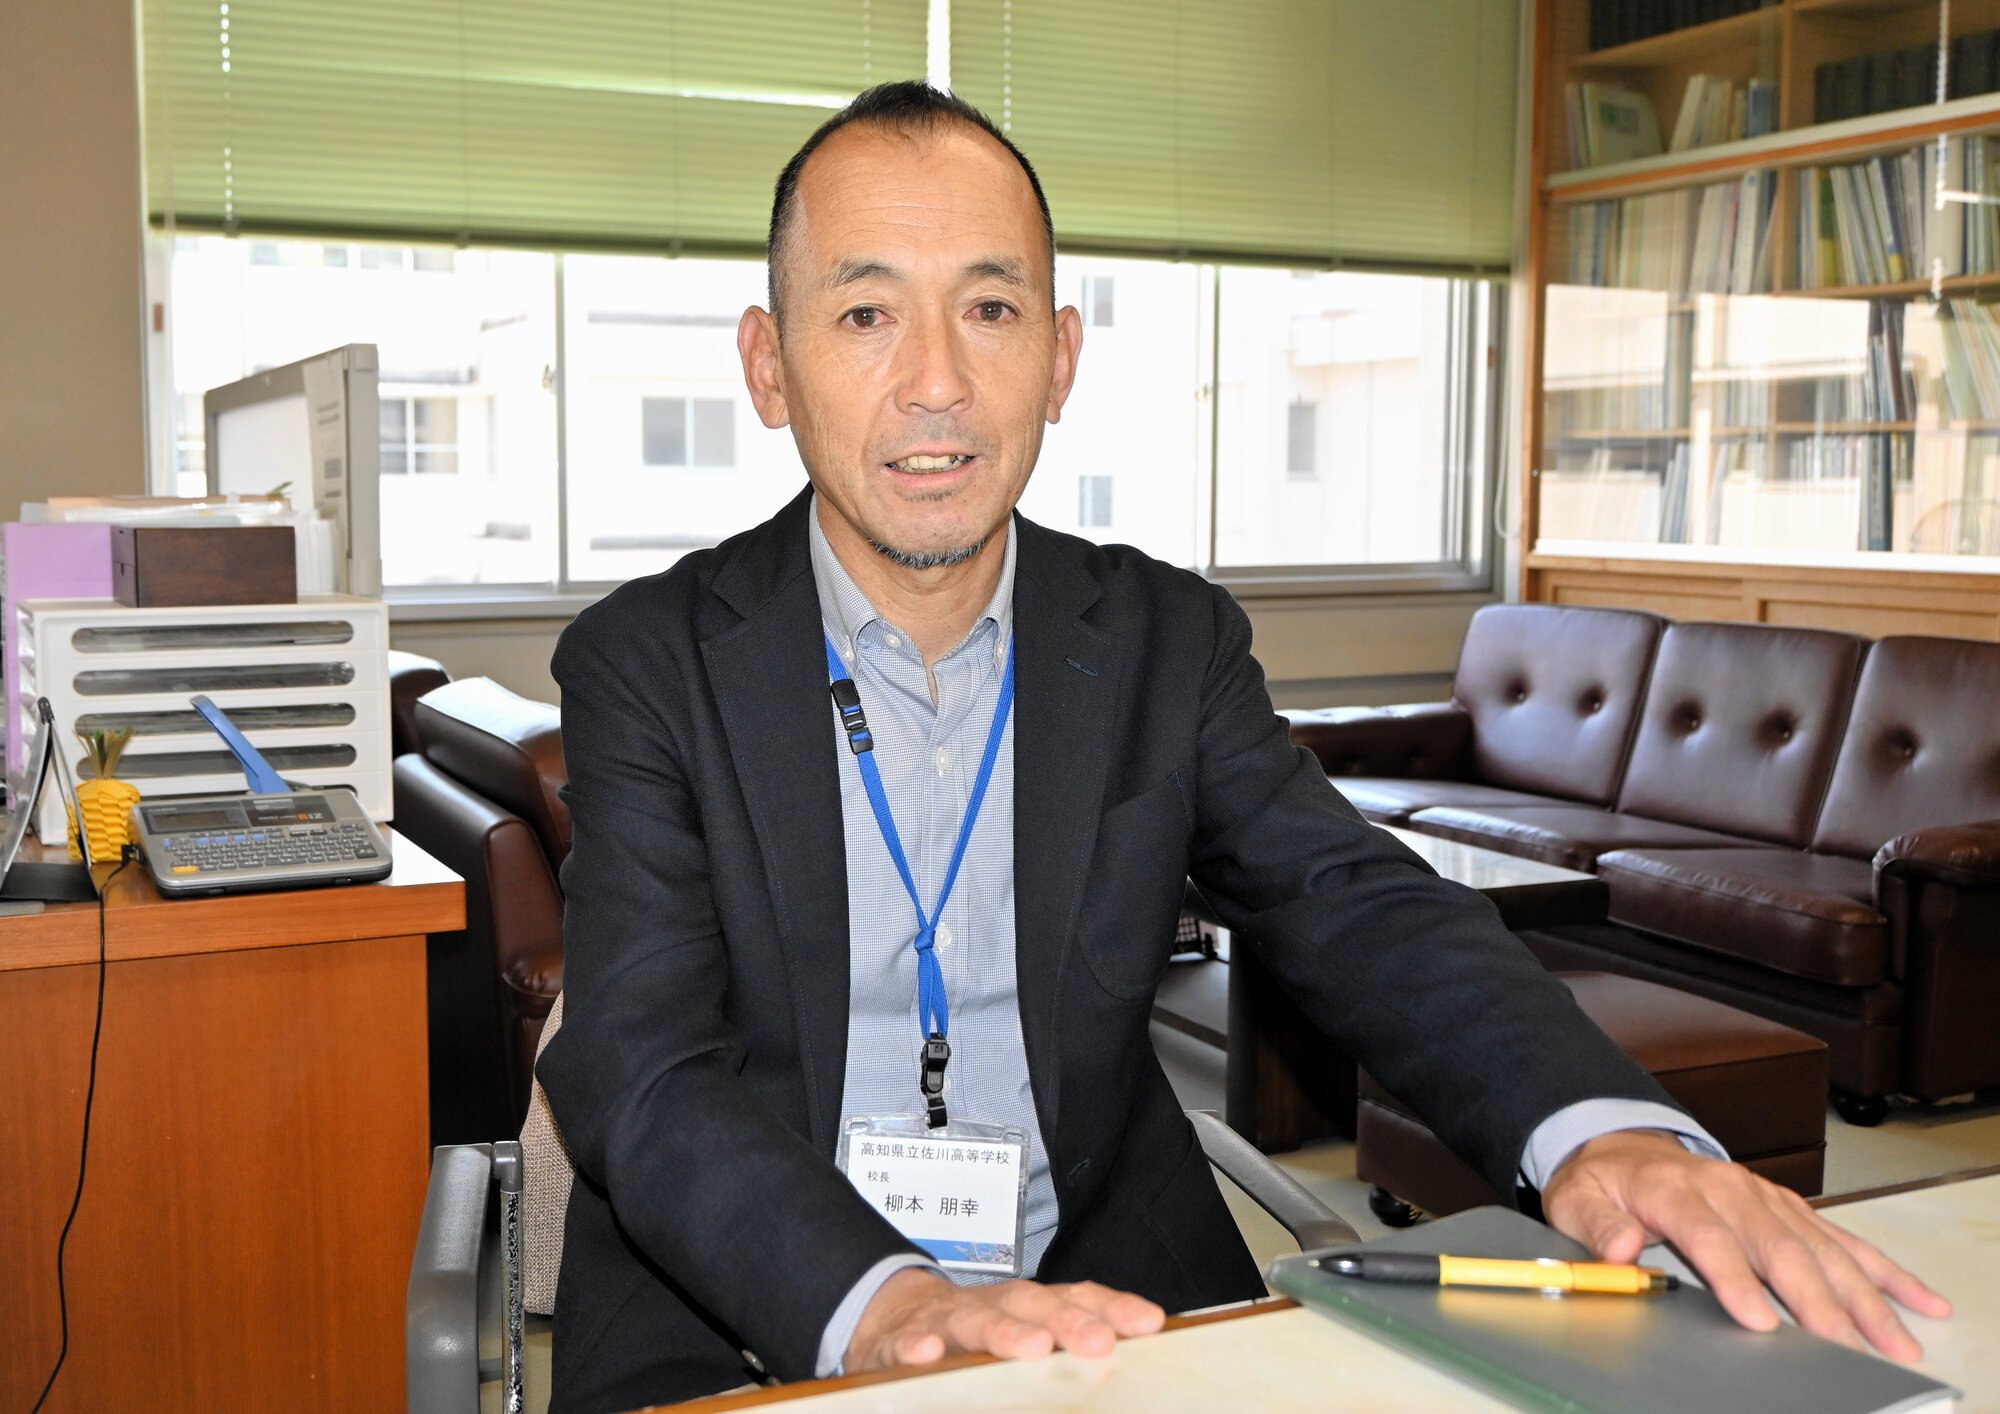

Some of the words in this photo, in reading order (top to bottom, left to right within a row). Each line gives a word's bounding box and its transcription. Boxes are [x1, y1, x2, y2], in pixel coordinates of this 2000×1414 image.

[861, 1142, 1010, 1164] 高知県立佐川高等学校
[868, 1170, 890, 1182] 校長
[884, 1193, 924, 1213] 柳本
[939, 1198, 979, 1217] 朋幸
